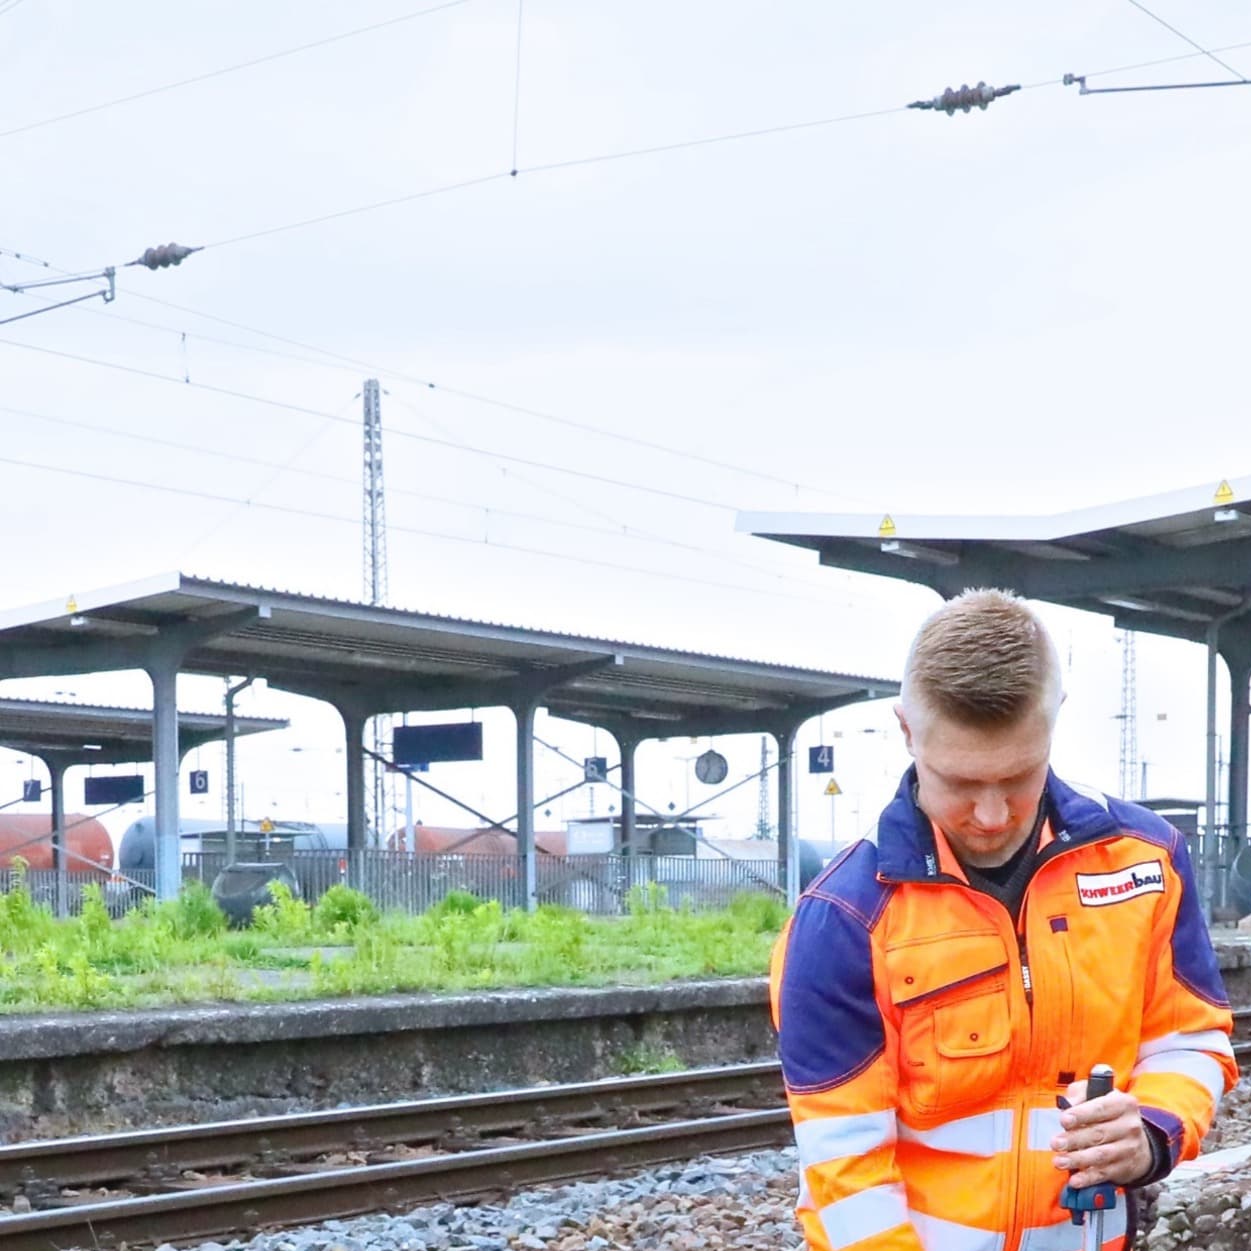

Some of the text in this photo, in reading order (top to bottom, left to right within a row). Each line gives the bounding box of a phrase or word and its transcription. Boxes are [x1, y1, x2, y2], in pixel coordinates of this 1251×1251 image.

[817, 747, 830, 768] 4
[24, 781, 33, 797] 7
[195, 773, 205, 790] 6
